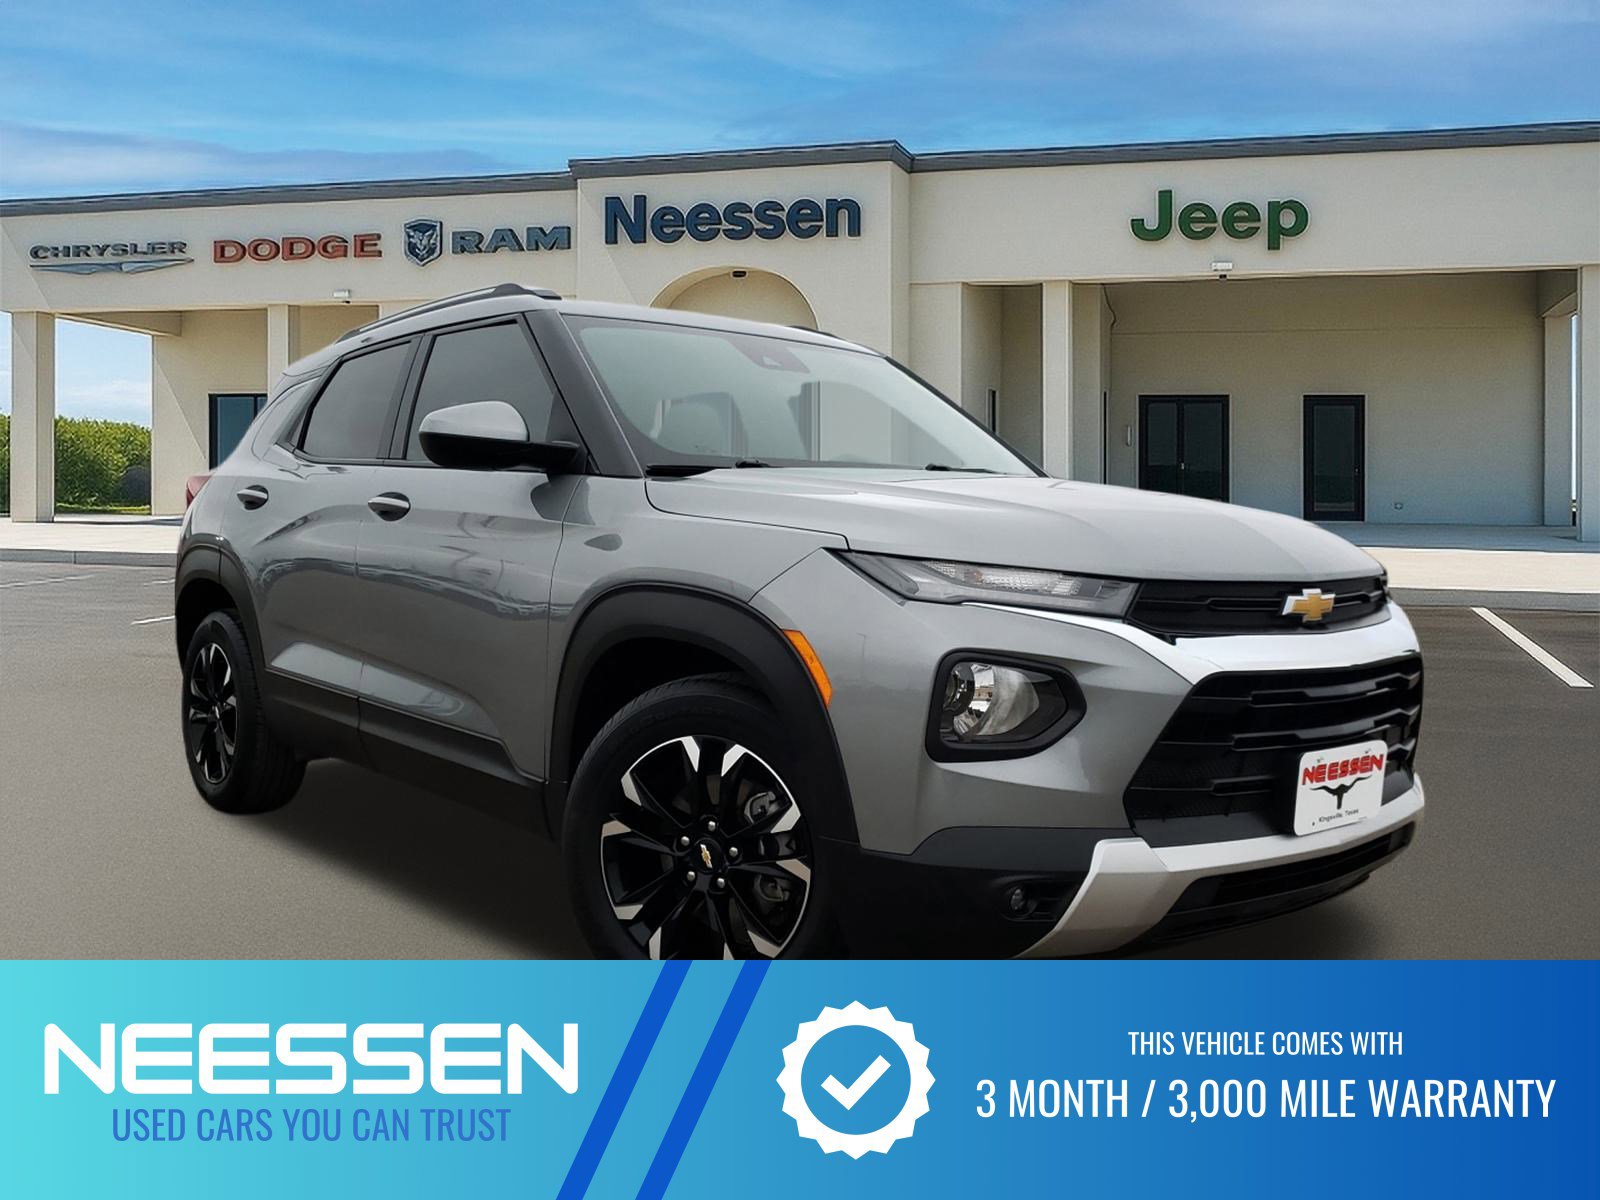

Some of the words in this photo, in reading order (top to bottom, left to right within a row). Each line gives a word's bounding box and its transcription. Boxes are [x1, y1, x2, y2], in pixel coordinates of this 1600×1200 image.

[604, 194, 862, 245] Neessen
[1130, 189, 1309, 250] Jeep
[29, 240, 188, 260] CHRYSLER
[213, 233, 383, 264] DODGE
[451, 225, 571, 254] RAM
[1302, 754, 1384, 785] NEESSEN
